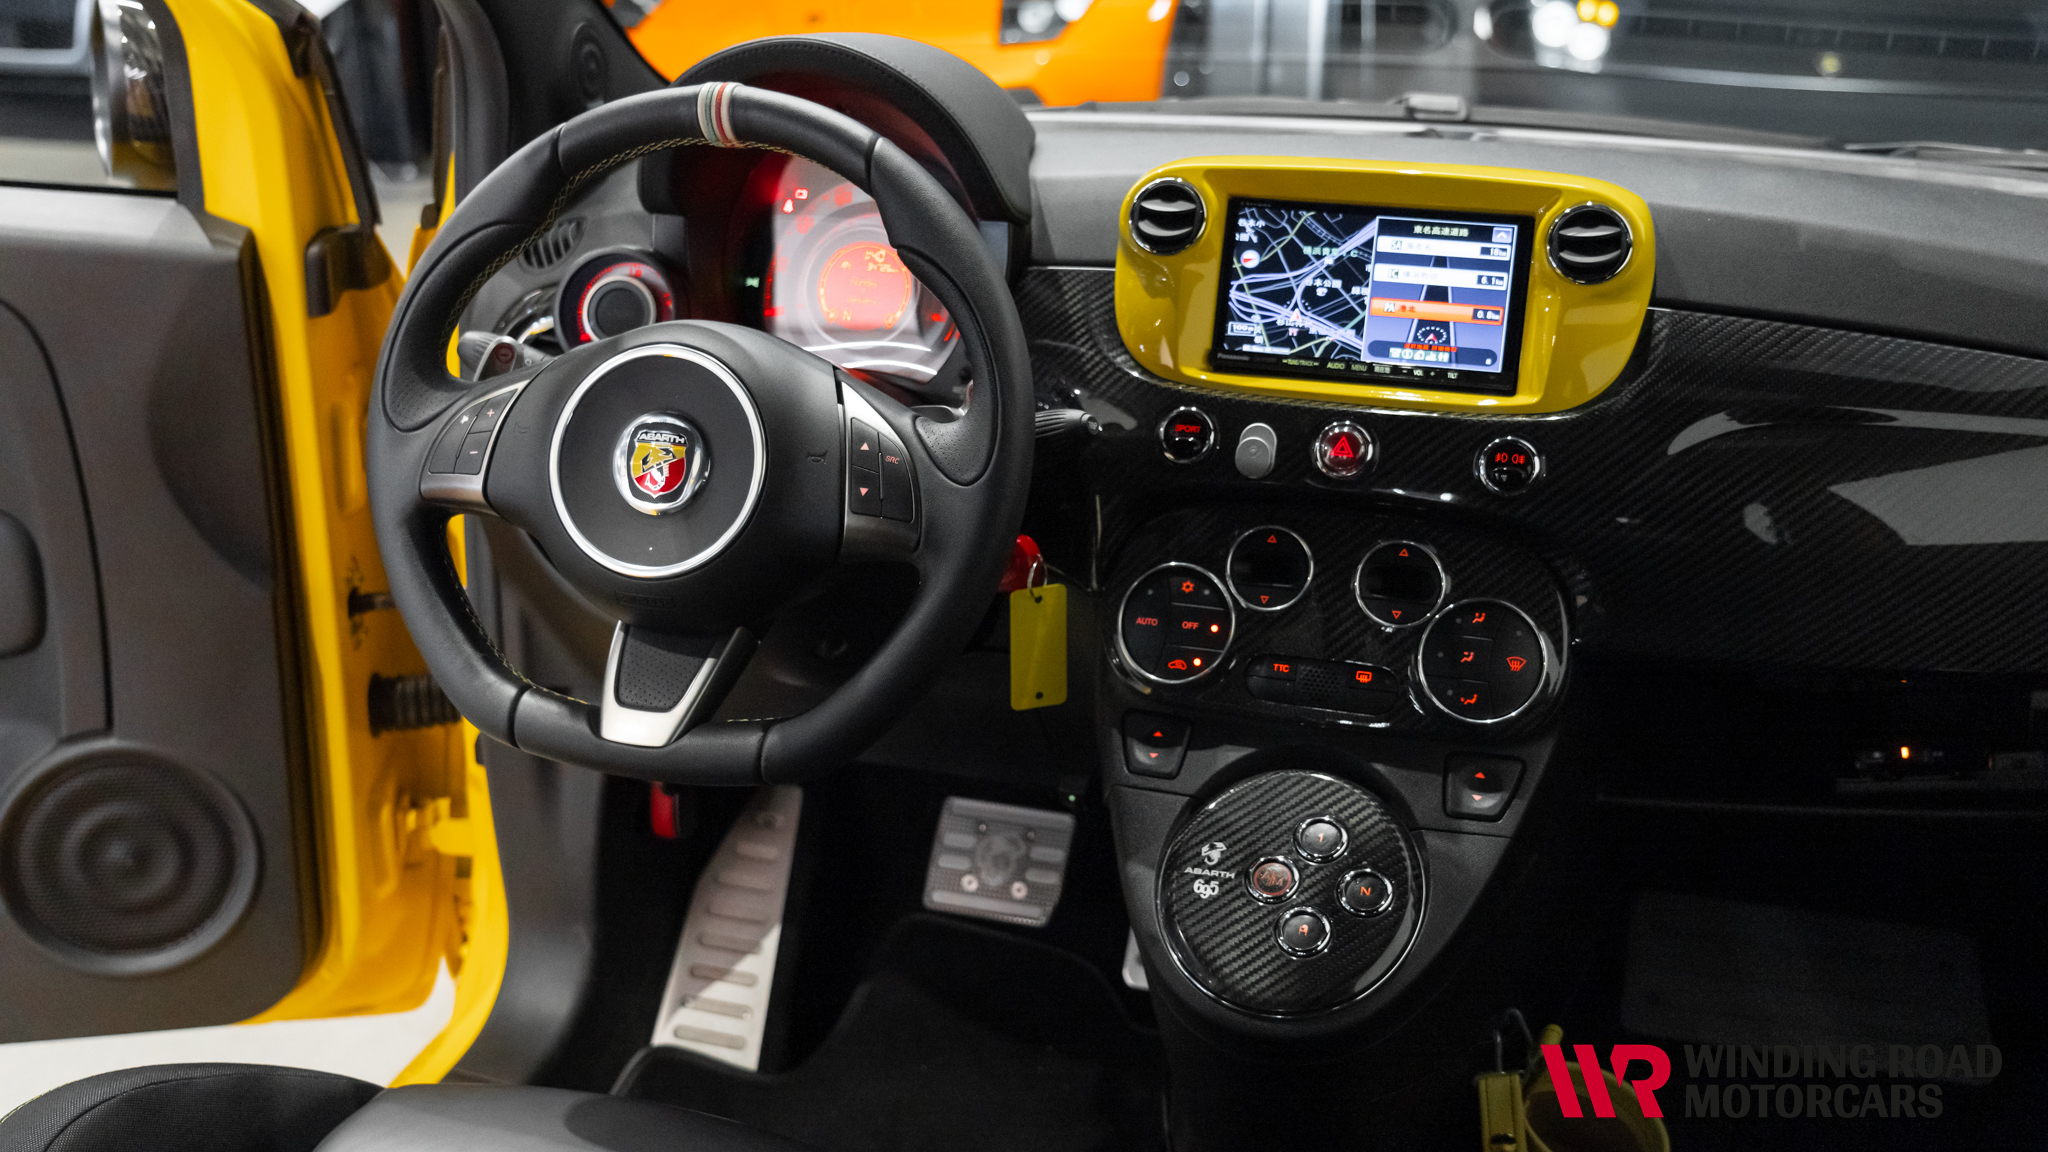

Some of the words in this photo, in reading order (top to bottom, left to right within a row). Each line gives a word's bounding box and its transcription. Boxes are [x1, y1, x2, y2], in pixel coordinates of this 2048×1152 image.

[1413, 225, 1470, 237] 東名高速道路
[1326, 360, 1346, 370] AUDIO
[1174, 424, 1202, 434] SPORT
[638, 433, 686, 444] ABARTH
[885, 455, 900, 465] SRC
[1136, 616, 1159, 627] AUTO
[1181, 620, 1200, 630] OFF
[1273, 663, 1291, 674] TTC
[1317, 832, 1325, 843] 1
[1184, 866, 1236, 880] ABARTH
[1193, 878, 1220, 900] 695
[1359, 885, 1372, 897] N
